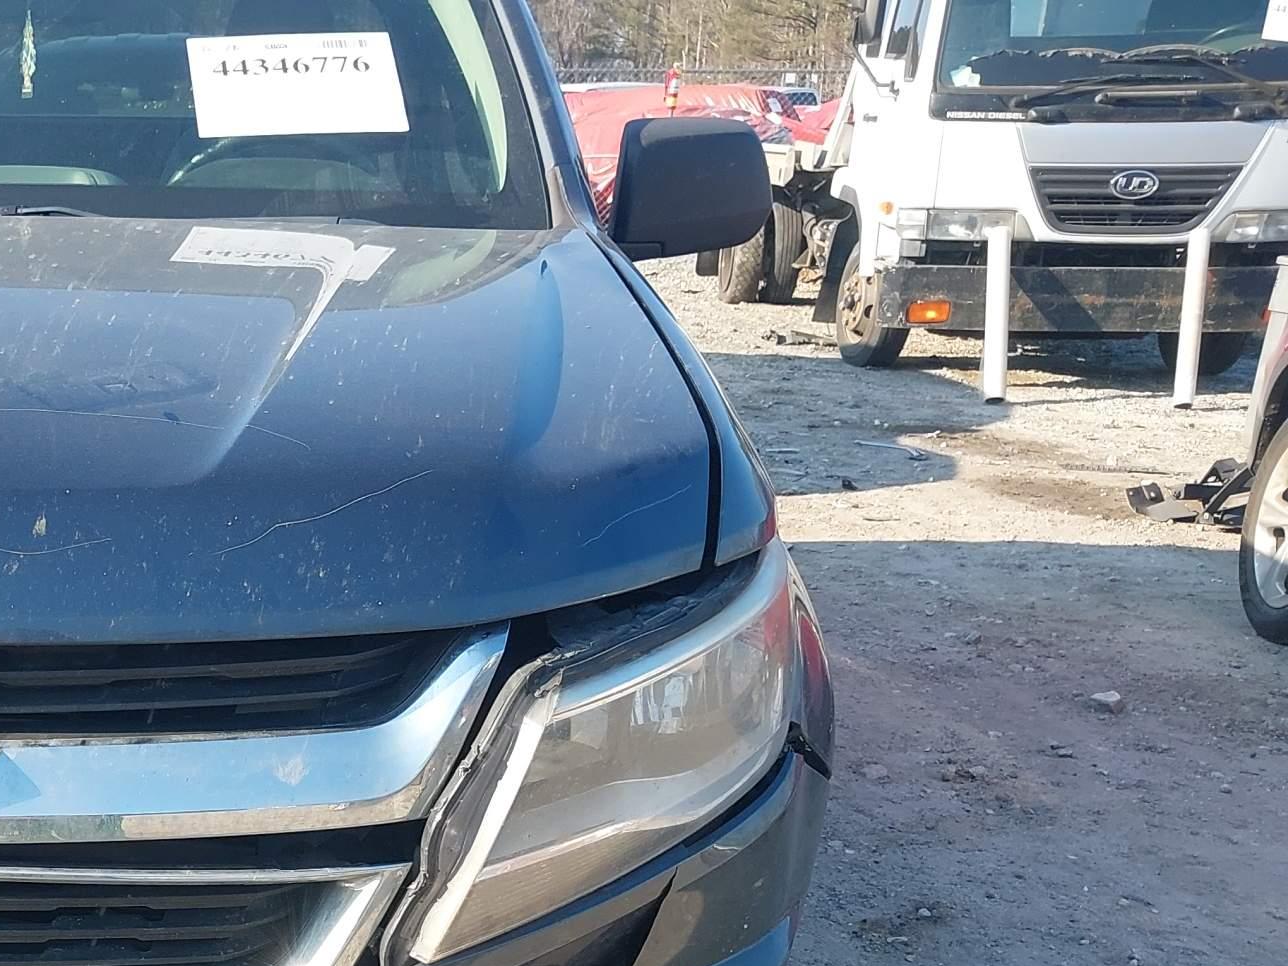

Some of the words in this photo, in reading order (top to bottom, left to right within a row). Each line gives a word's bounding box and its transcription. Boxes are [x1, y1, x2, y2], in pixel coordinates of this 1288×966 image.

[212, 55, 371, 77] 44346776
[946, 110, 985, 119] NISSAN
[987, 111, 1026, 120] DIESEL
[1116, 176, 1154, 193] UD
